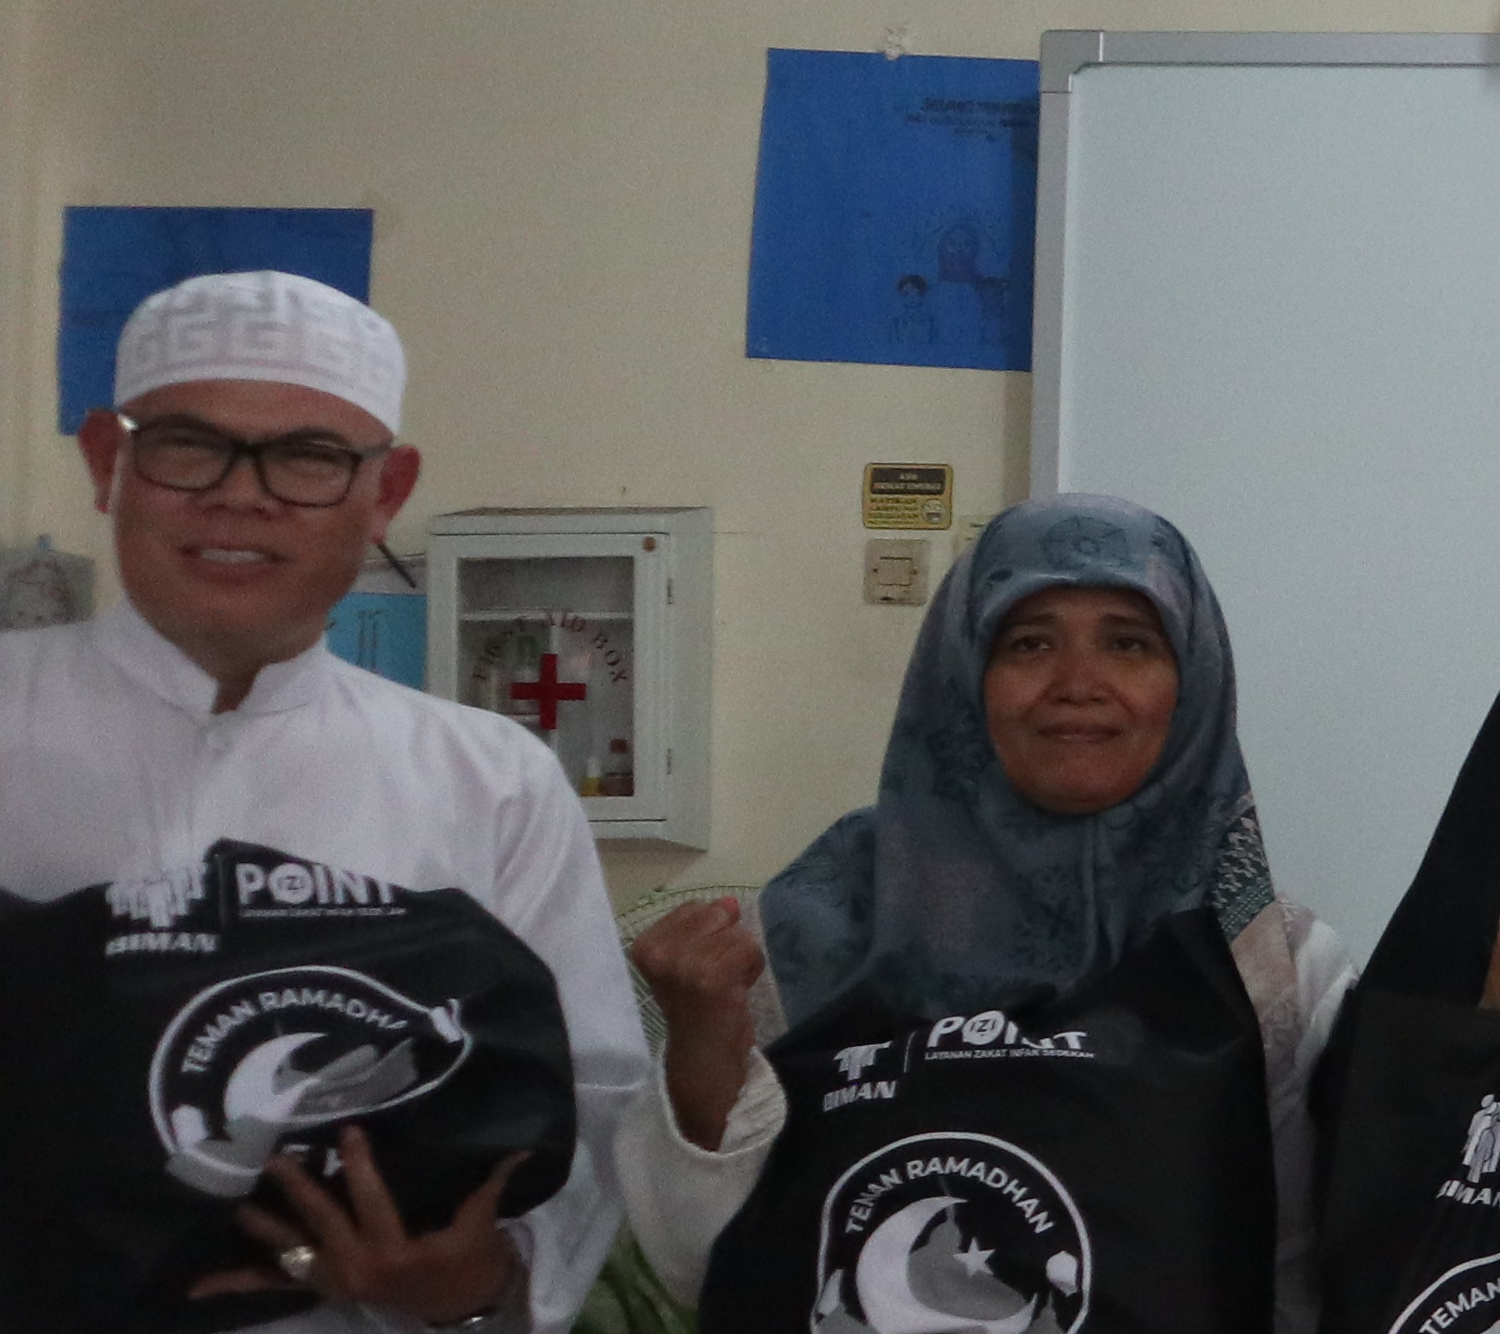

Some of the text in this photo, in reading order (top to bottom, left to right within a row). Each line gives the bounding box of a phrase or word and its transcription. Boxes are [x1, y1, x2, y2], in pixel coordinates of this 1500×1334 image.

[593, 633, 628, 683] BOX
[105, 931, 218, 957] BIMAN
[181, 999, 259, 1074] TEMAN
[973, 1049, 1008, 1059] ZAKAT
[906, 1155, 1056, 1236] RAMADHAN
